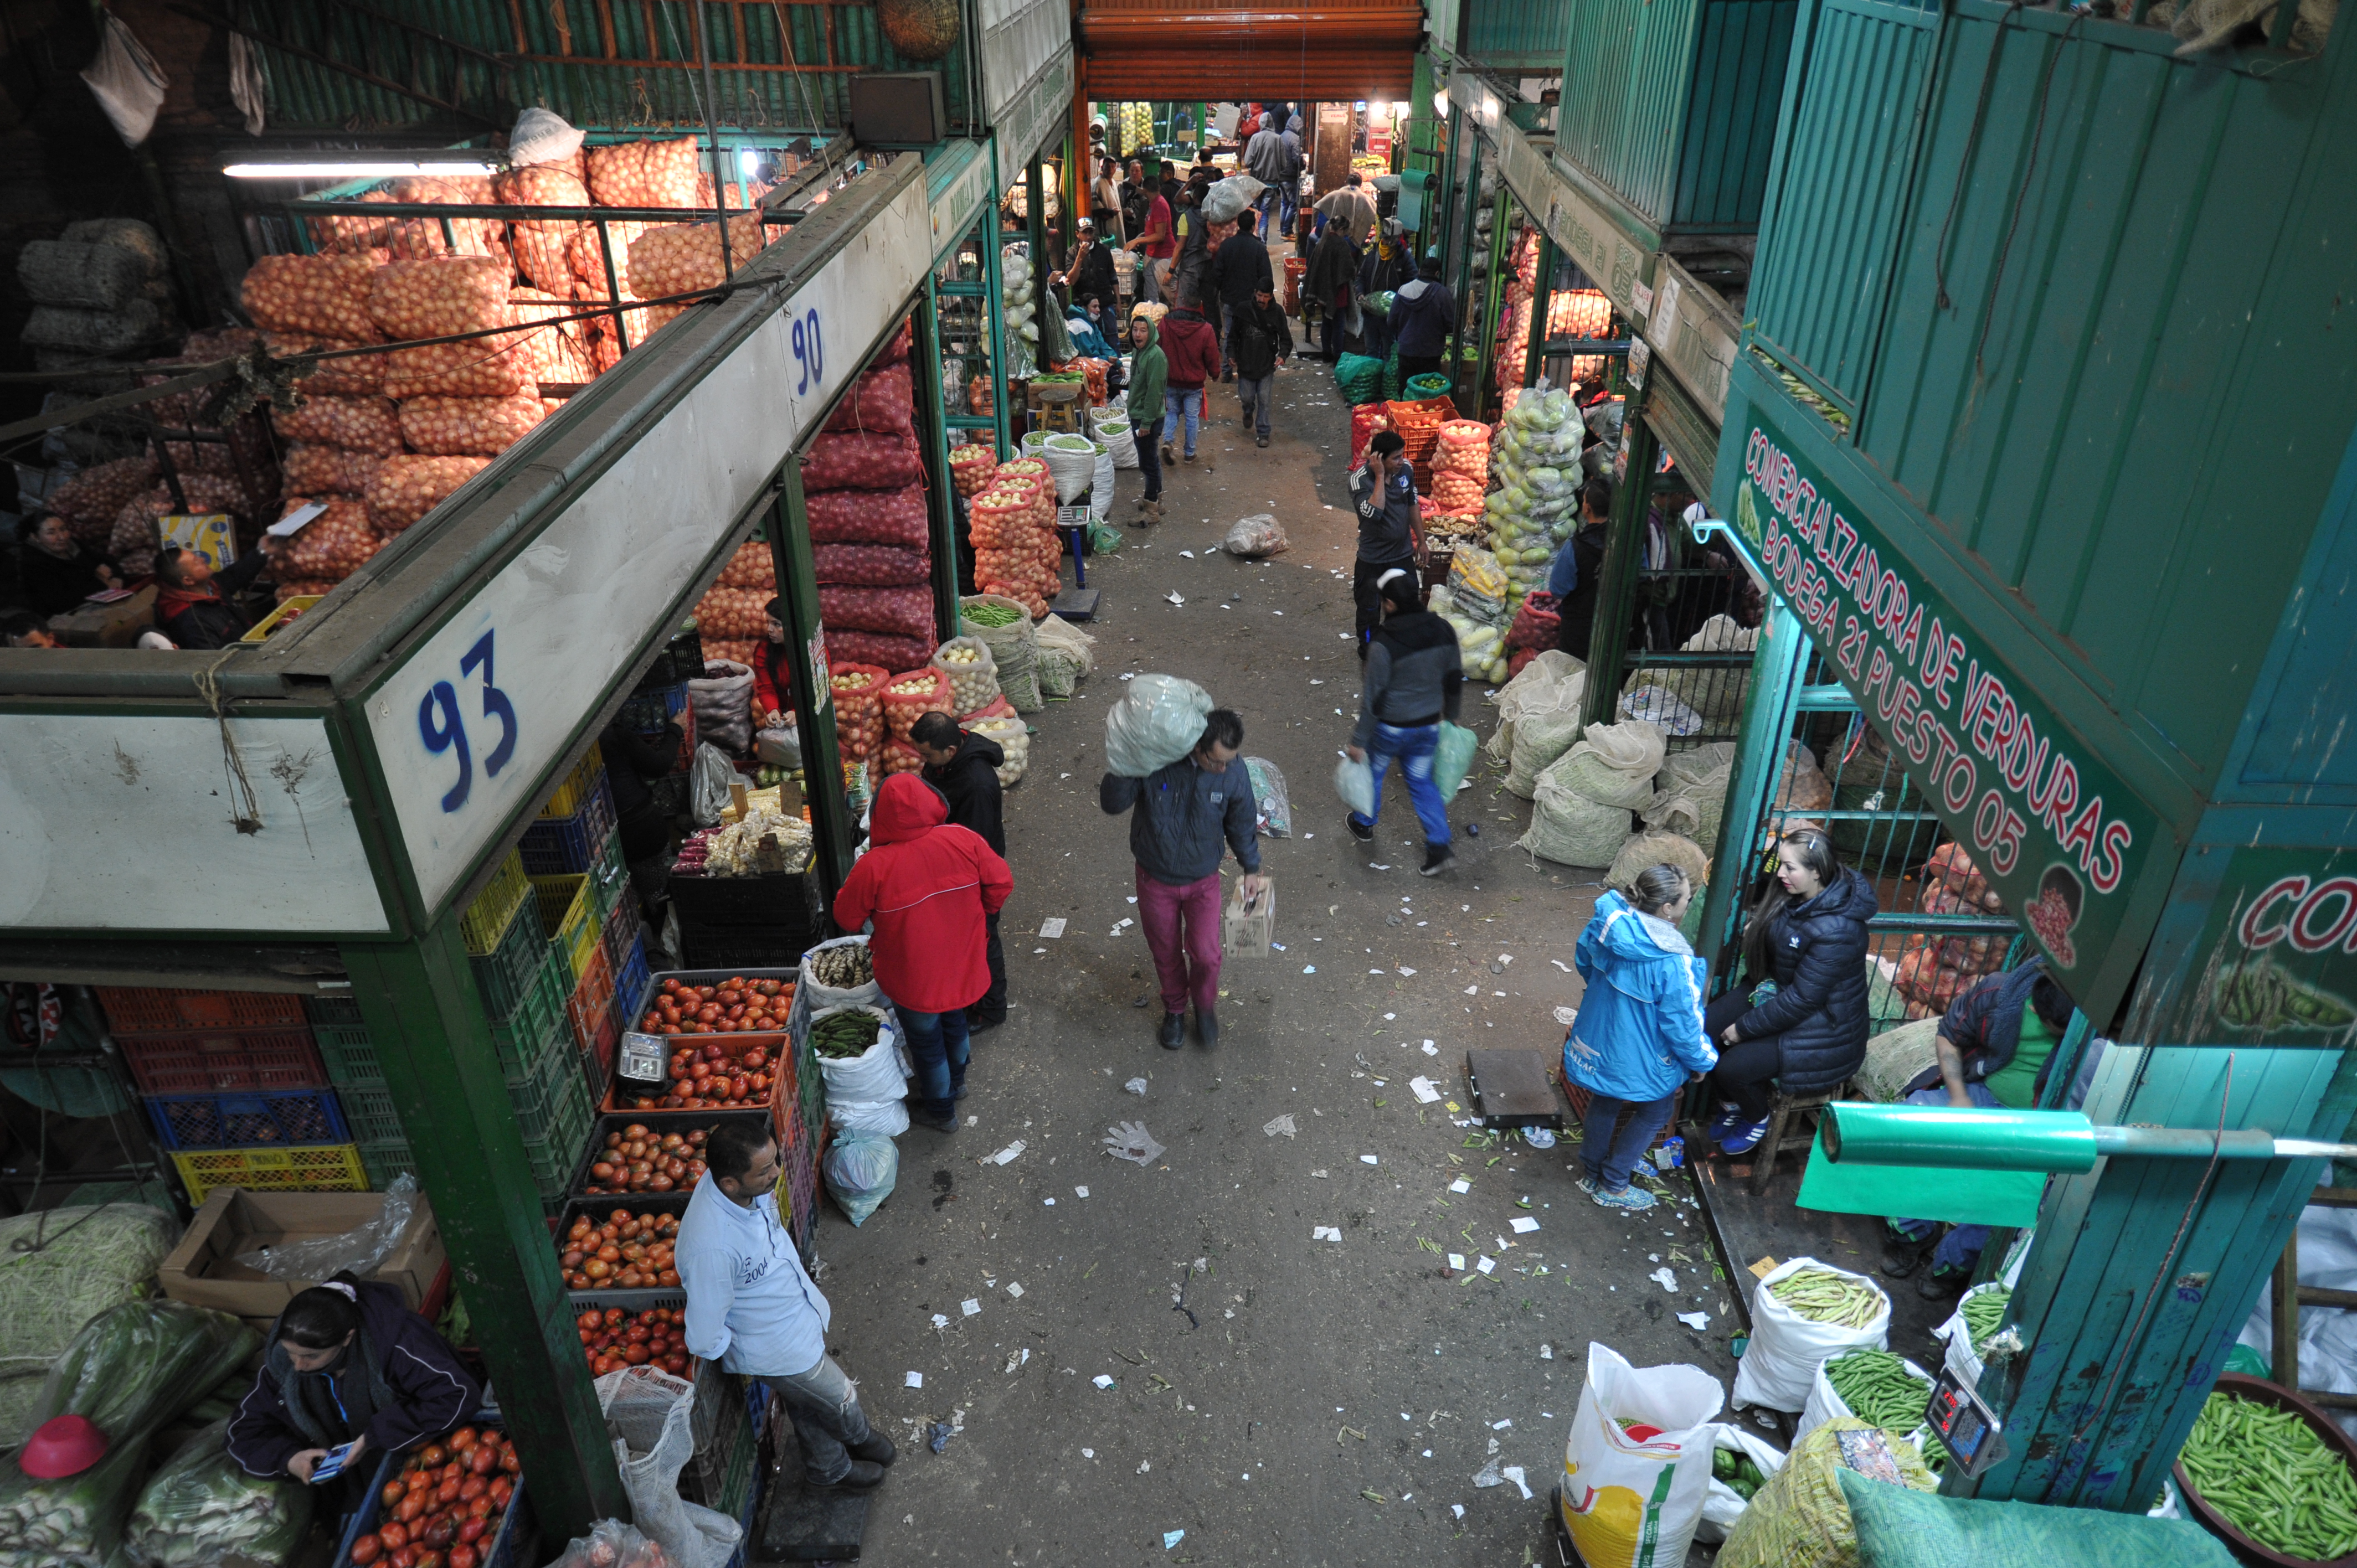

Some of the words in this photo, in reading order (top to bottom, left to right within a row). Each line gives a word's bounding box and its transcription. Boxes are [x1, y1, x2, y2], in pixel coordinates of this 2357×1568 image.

[1017, 132, 1036, 169] BODEGA
[1559, 206, 1594, 266] BODEGA
[1594, 240, 1608, 278] 21
[1610, 259, 1634, 308] 03
[792, 308, 822, 395] 90
[1746, 427, 1923, 666] COMERCIALIZADORA
[1920, 617, 1966, 710] DE
[1961, 659, 2132, 894] VERDURAS
[1762, 517, 1839, 647] BODEGA
[1837, 615, 1869, 681] 21
[1864, 646, 1977, 813] PUESTO
[1973, 788, 2026, 877] 05
[419, 627, 517, 813] 93
[2238, 875, 2357, 953] CO
[744, 1256, 768, 1284] 2004
[1645, 1520, 1653, 1544] SPECIAL
